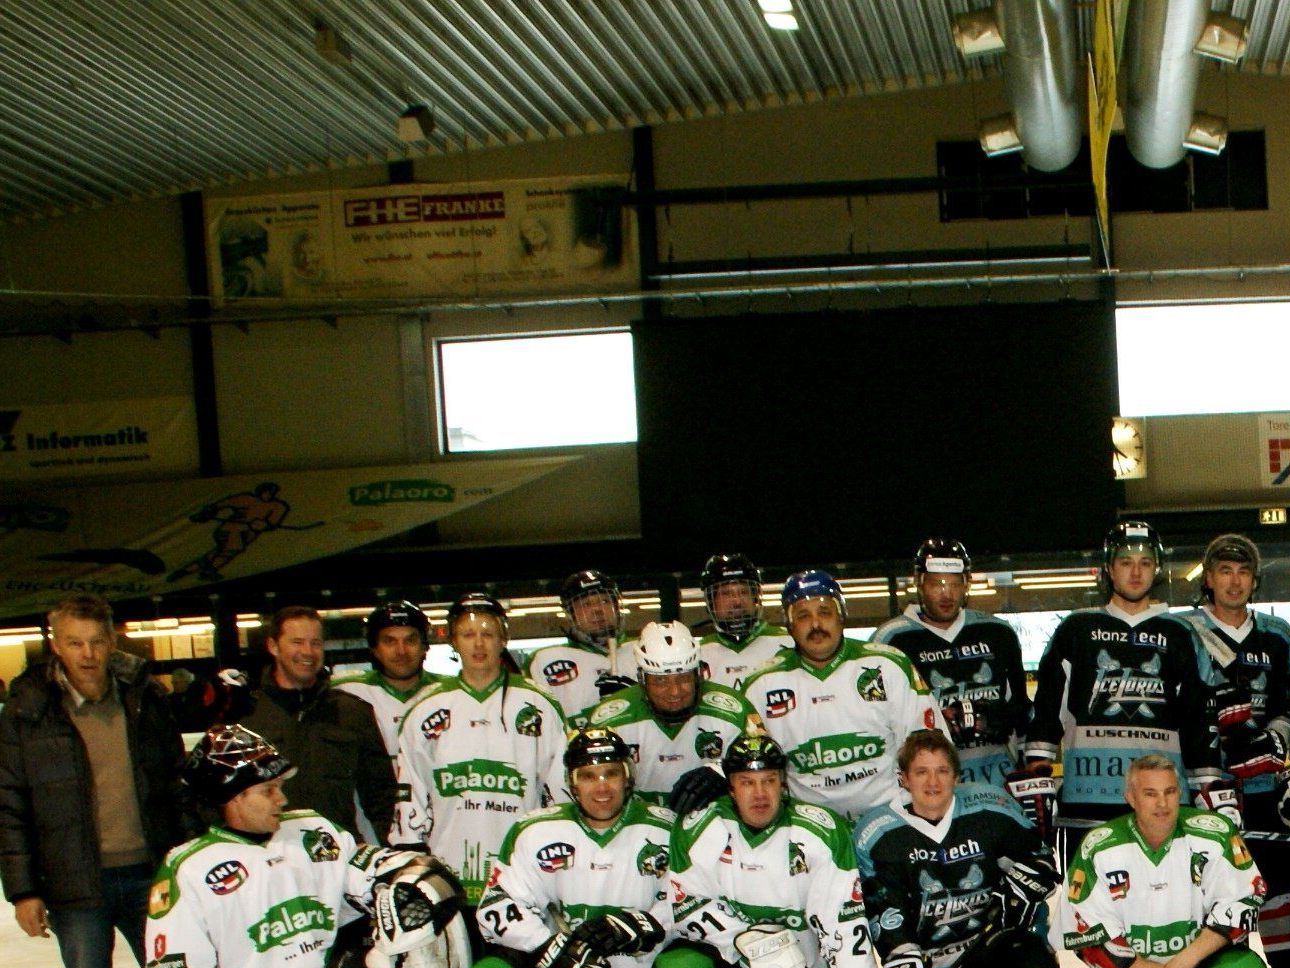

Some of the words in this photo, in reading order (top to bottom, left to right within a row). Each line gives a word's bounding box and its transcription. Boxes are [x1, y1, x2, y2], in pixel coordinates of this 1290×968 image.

[1267, 420, 1290, 431] Tore
[27, 426, 149, 451] Informatik
[356, 481, 448, 502] Palaoro
[798, 742, 878, 769] Palaoro
[825, 776, 841, 788] Ihr
[844, 767, 878, 785] Maler
[464, 799, 482, 812] Ihr
[485, 800, 519, 813] Maler
[538, 844, 573, 862] INL
[208, 861, 241, 884] INL
[484, 902, 523, 937] 24
